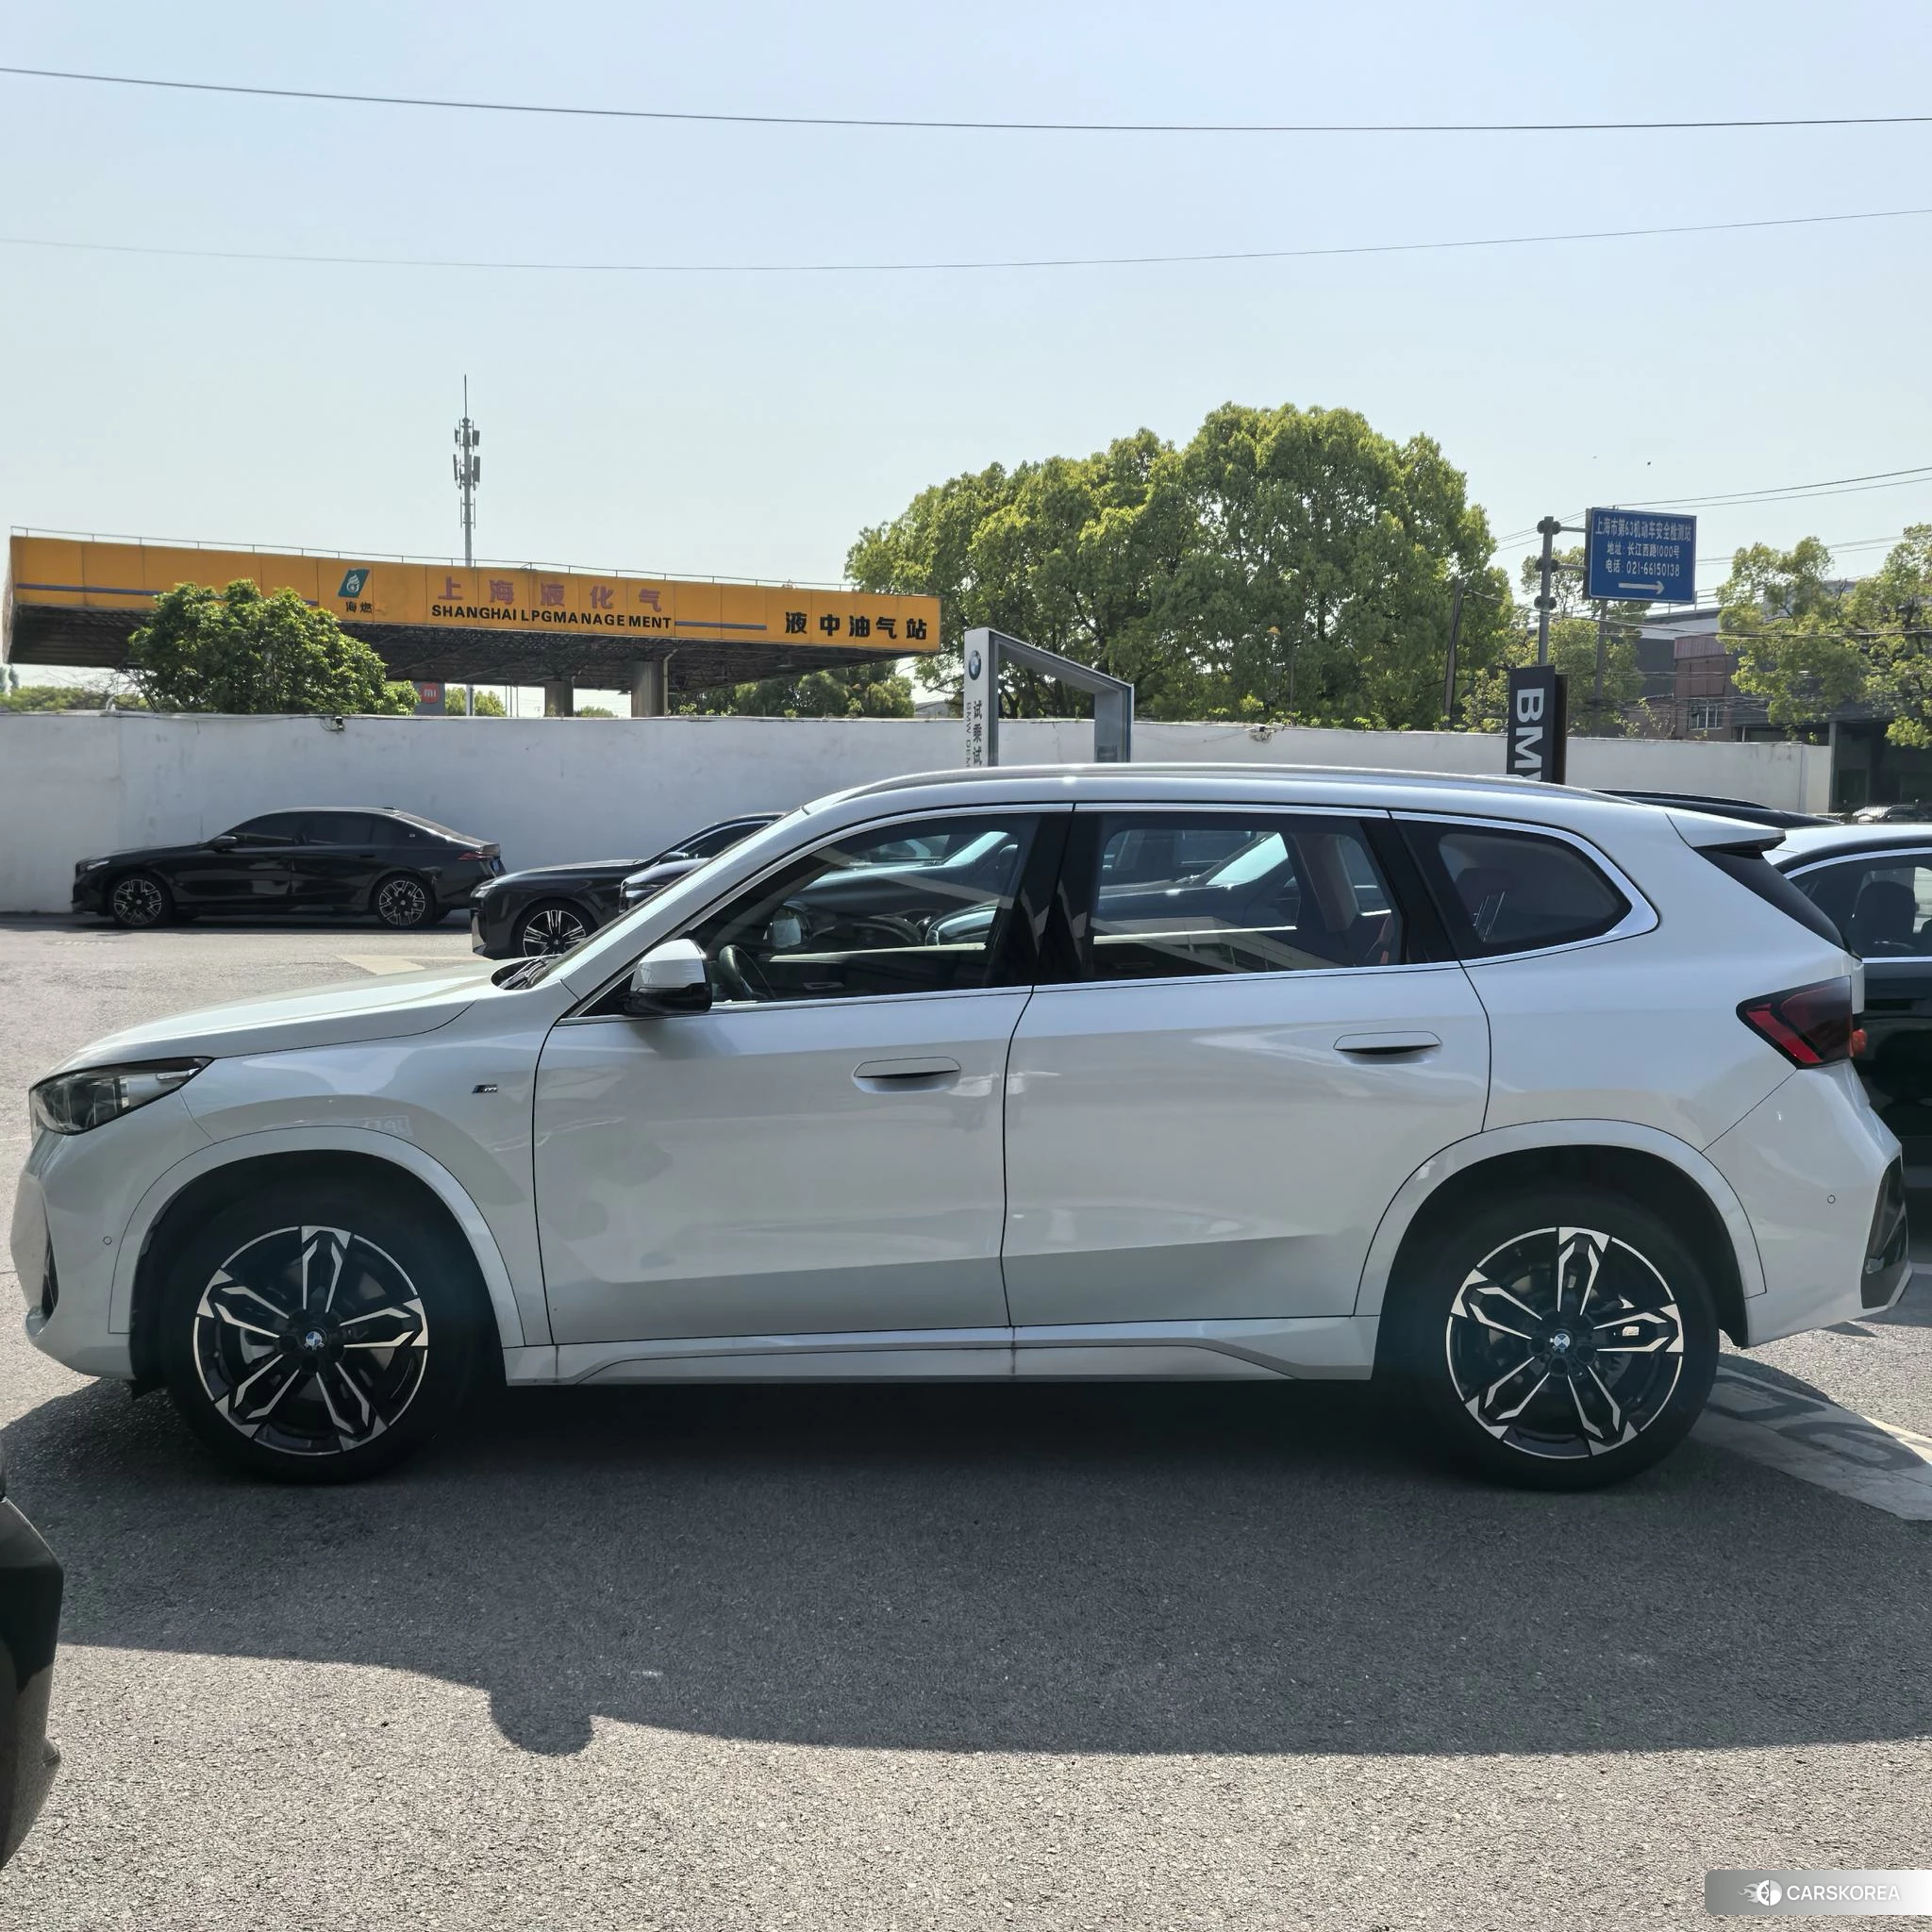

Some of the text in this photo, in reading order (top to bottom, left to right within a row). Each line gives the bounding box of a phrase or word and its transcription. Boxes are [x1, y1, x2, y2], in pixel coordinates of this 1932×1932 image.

[437, 575, 662, 612] 上海液化气
[431, 604, 517, 621] SHANGHAI
[785, 611, 927, 641] 液中油气站
[1514, 688, 1544, 781] BM
